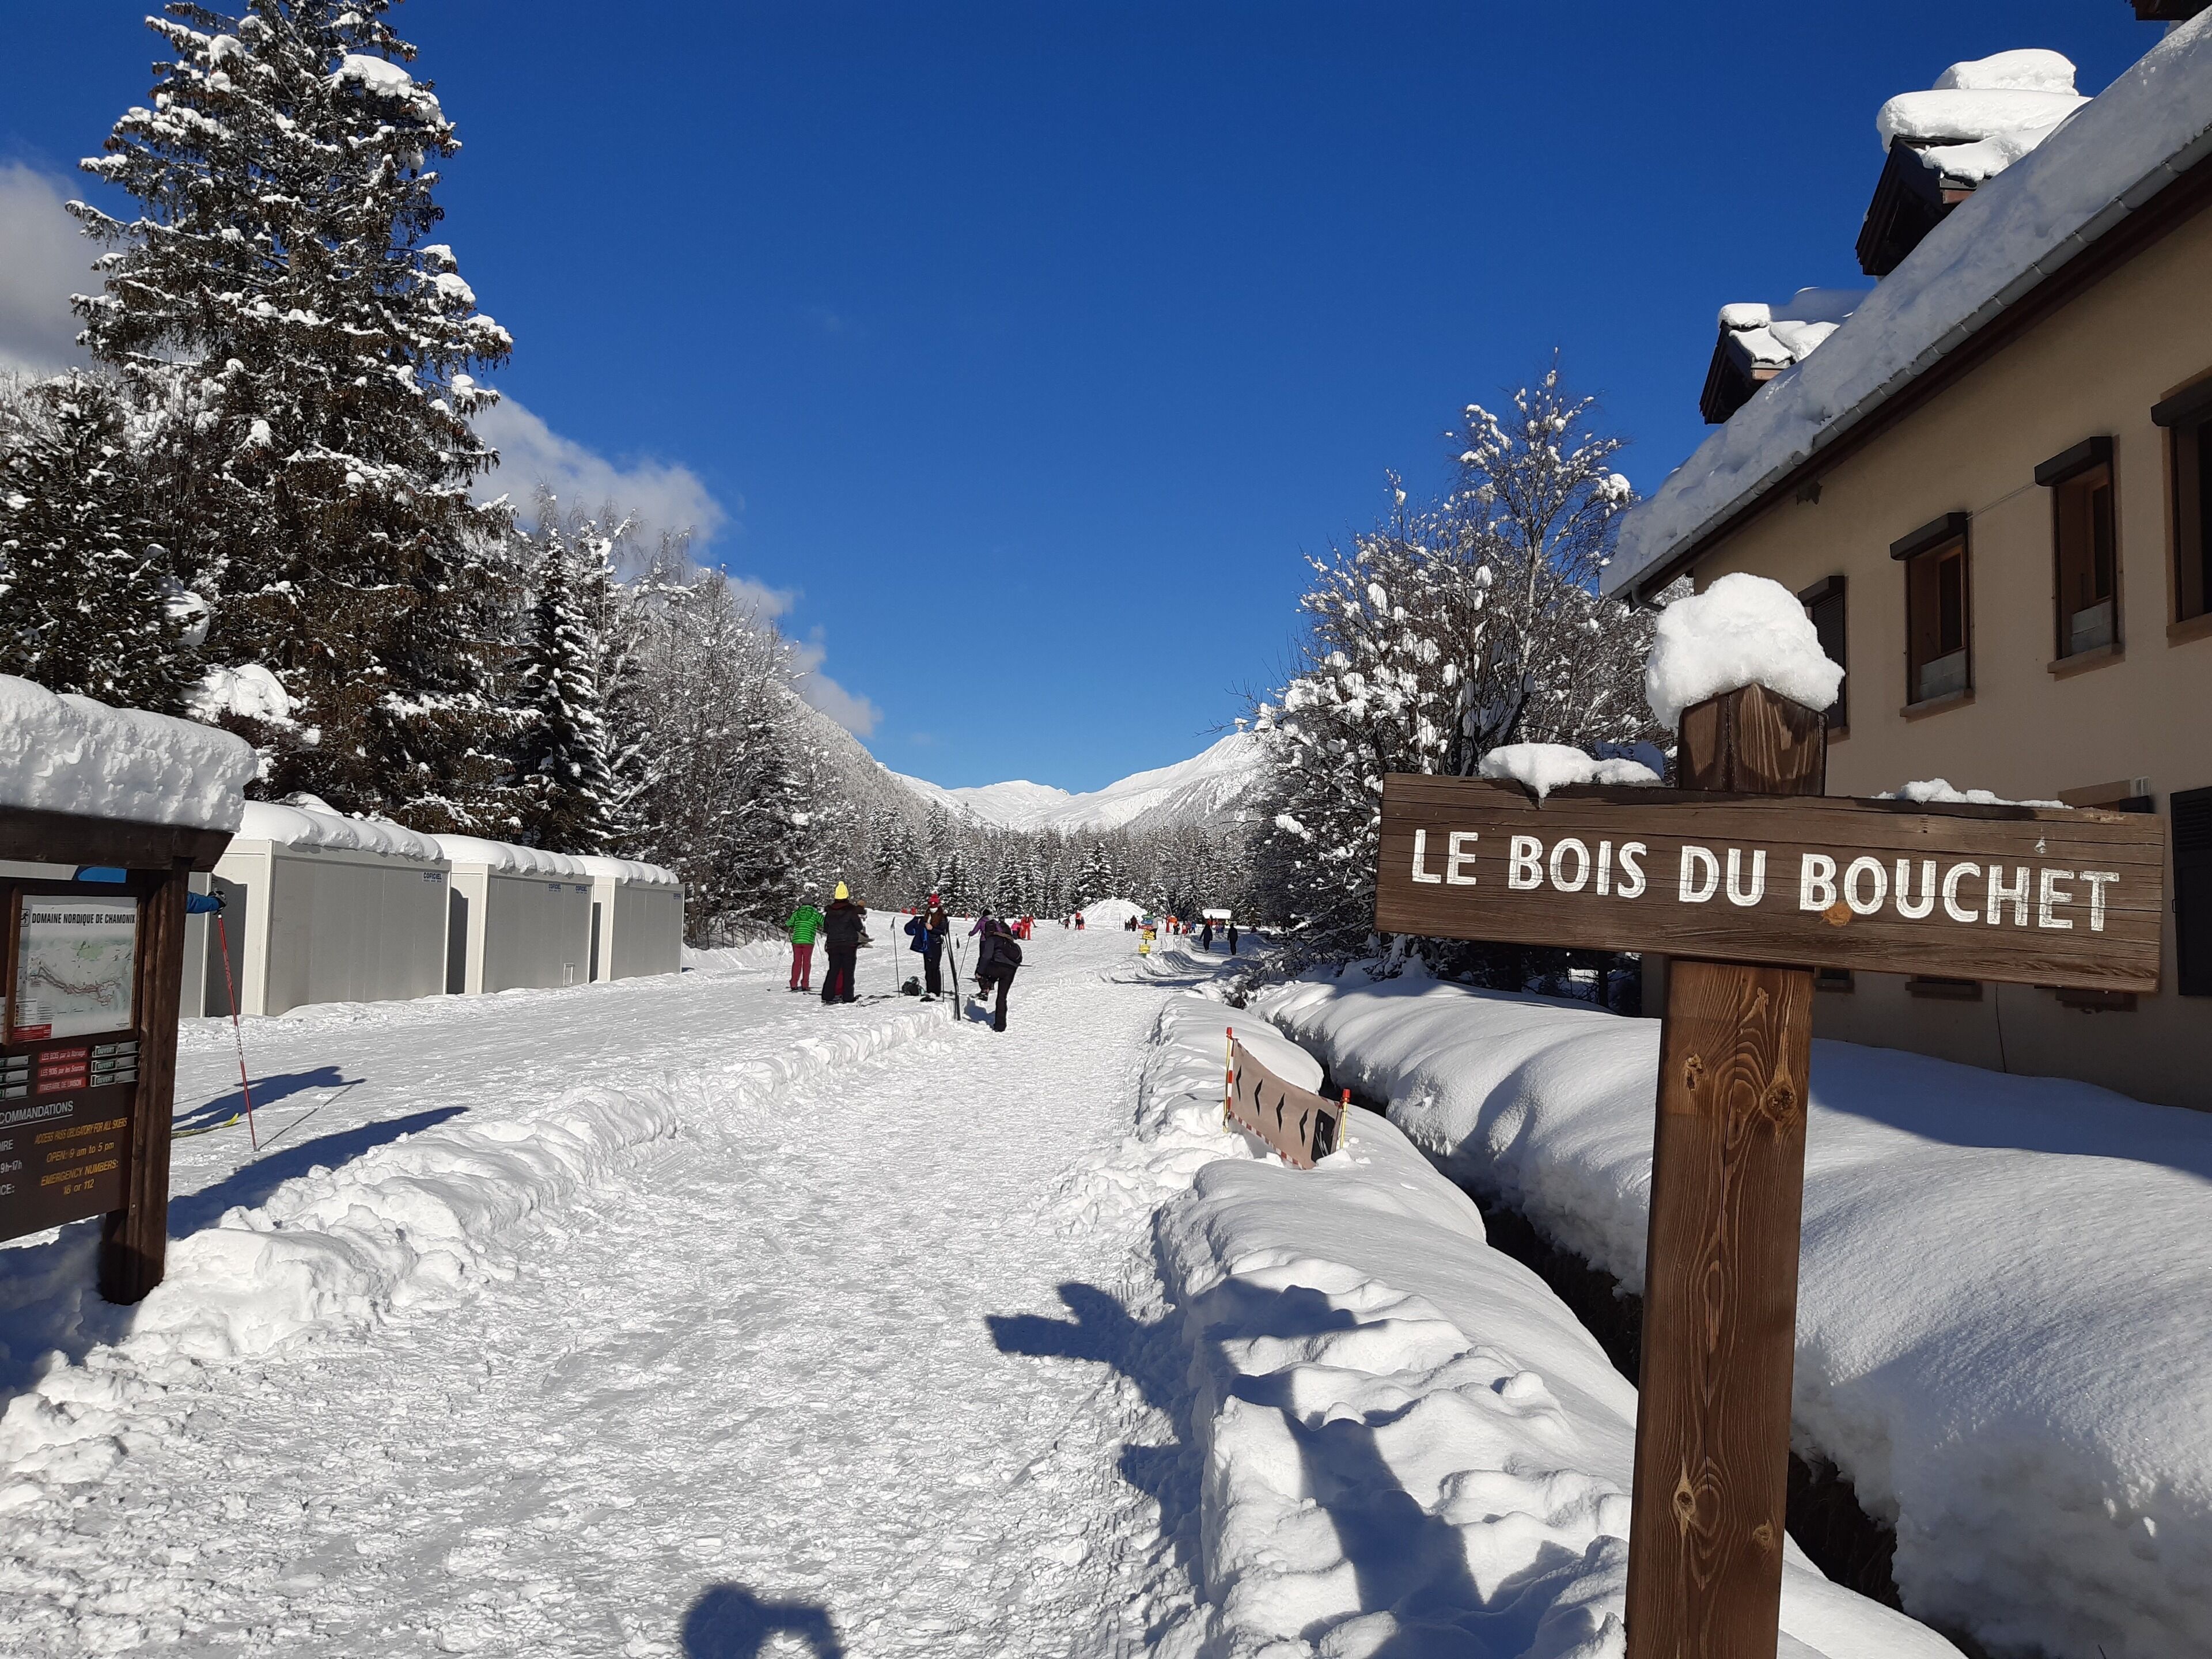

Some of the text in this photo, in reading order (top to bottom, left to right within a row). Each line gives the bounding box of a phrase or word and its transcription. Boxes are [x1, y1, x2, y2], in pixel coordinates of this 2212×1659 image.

[1411, 828, 2120, 932] LE BOIS DU BOUCHET
[32, 913, 135, 926] DOMAINE NORDIQUE DE CHAMONIX
[97, 1062, 114, 1070] OUVERT
[97, 1075, 113, 1084] OUVERT
[103, 1120, 112, 1131] ALL
[0, 1139, 14, 1152] IRE
[46, 1142, 115, 1163] OPEN: 9 am to 5 pm
[1, 1160, 22, 1173] 9h-17h
[41, 1159, 119, 1186] EMERGENCY NUMBERS:
[0, 1183, 14, 1195] CE:
[63, 1179, 94, 1195] 18 or 112
